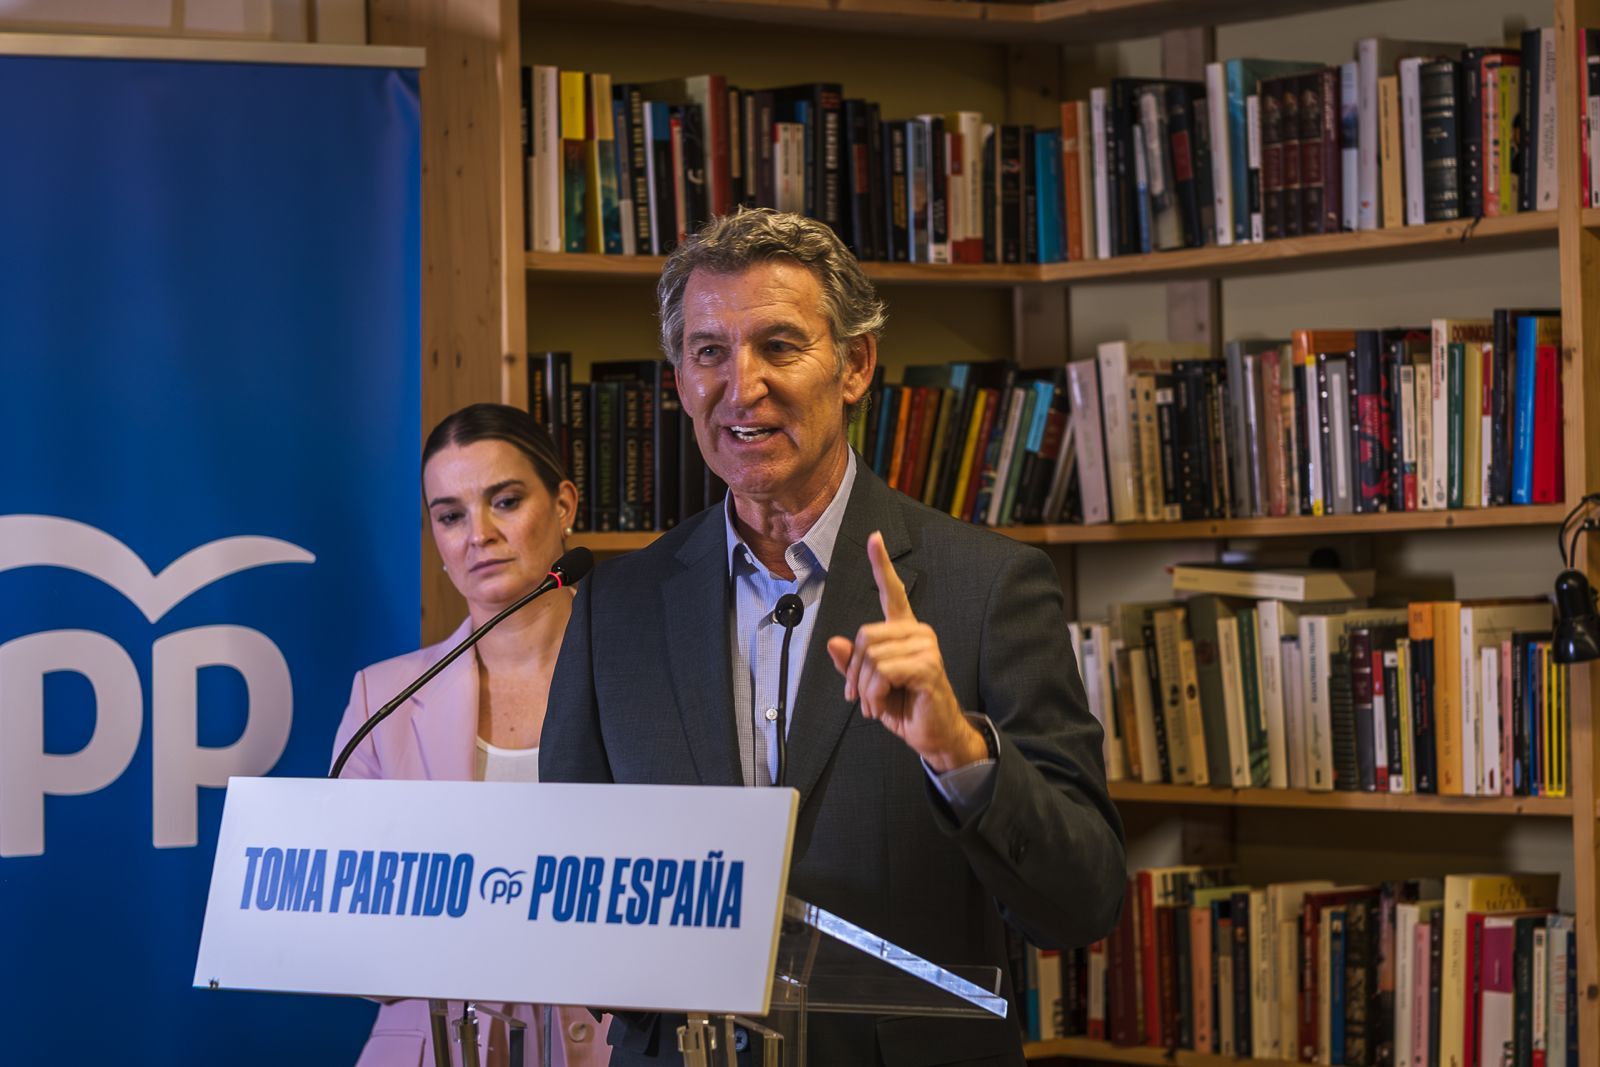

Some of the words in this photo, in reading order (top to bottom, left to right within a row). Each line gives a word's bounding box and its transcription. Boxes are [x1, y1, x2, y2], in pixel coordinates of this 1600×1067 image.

[239, 847, 328, 912] TOMA
[329, 850, 475, 918] PARTIDO
[527, 854, 605, 924] POR
[605, 849, 745, 929] ESPAÑA
